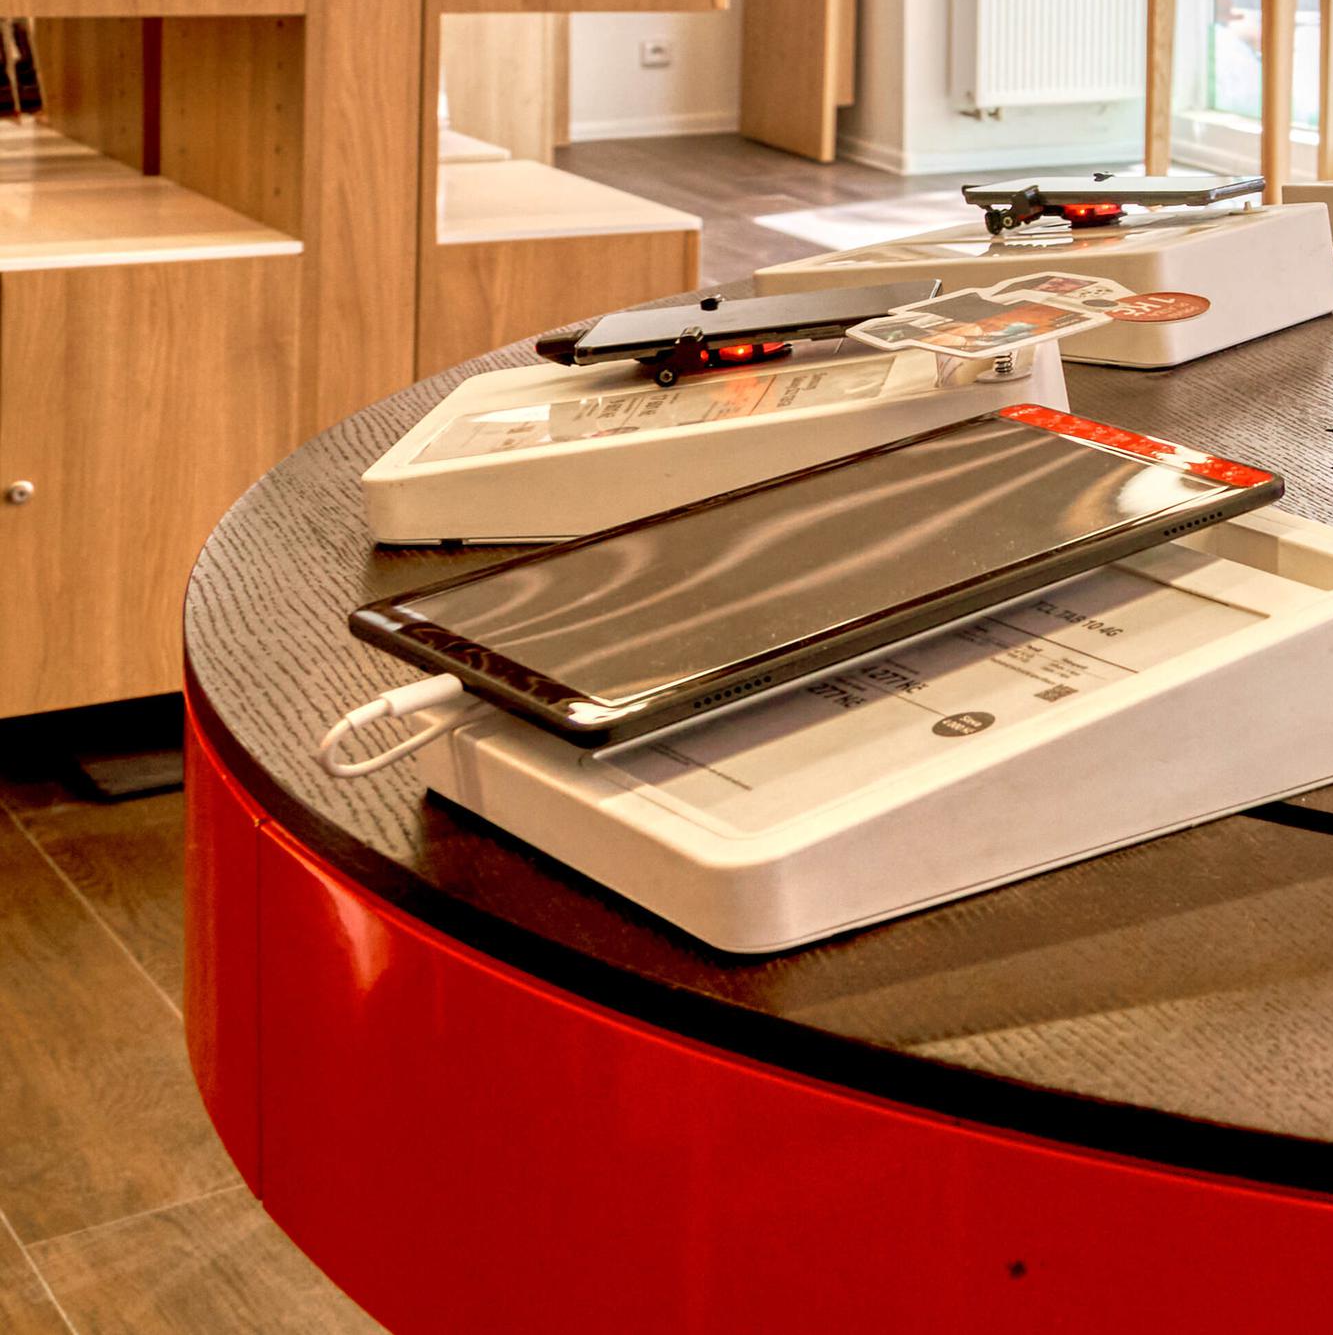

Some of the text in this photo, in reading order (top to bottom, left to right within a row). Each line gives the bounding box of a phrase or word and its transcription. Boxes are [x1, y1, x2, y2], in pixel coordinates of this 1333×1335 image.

[1061, 609, 1087, 625] TAB
[1082, 619, 1104, 631] 10
[1100, 626, 1123, 638] 4G
